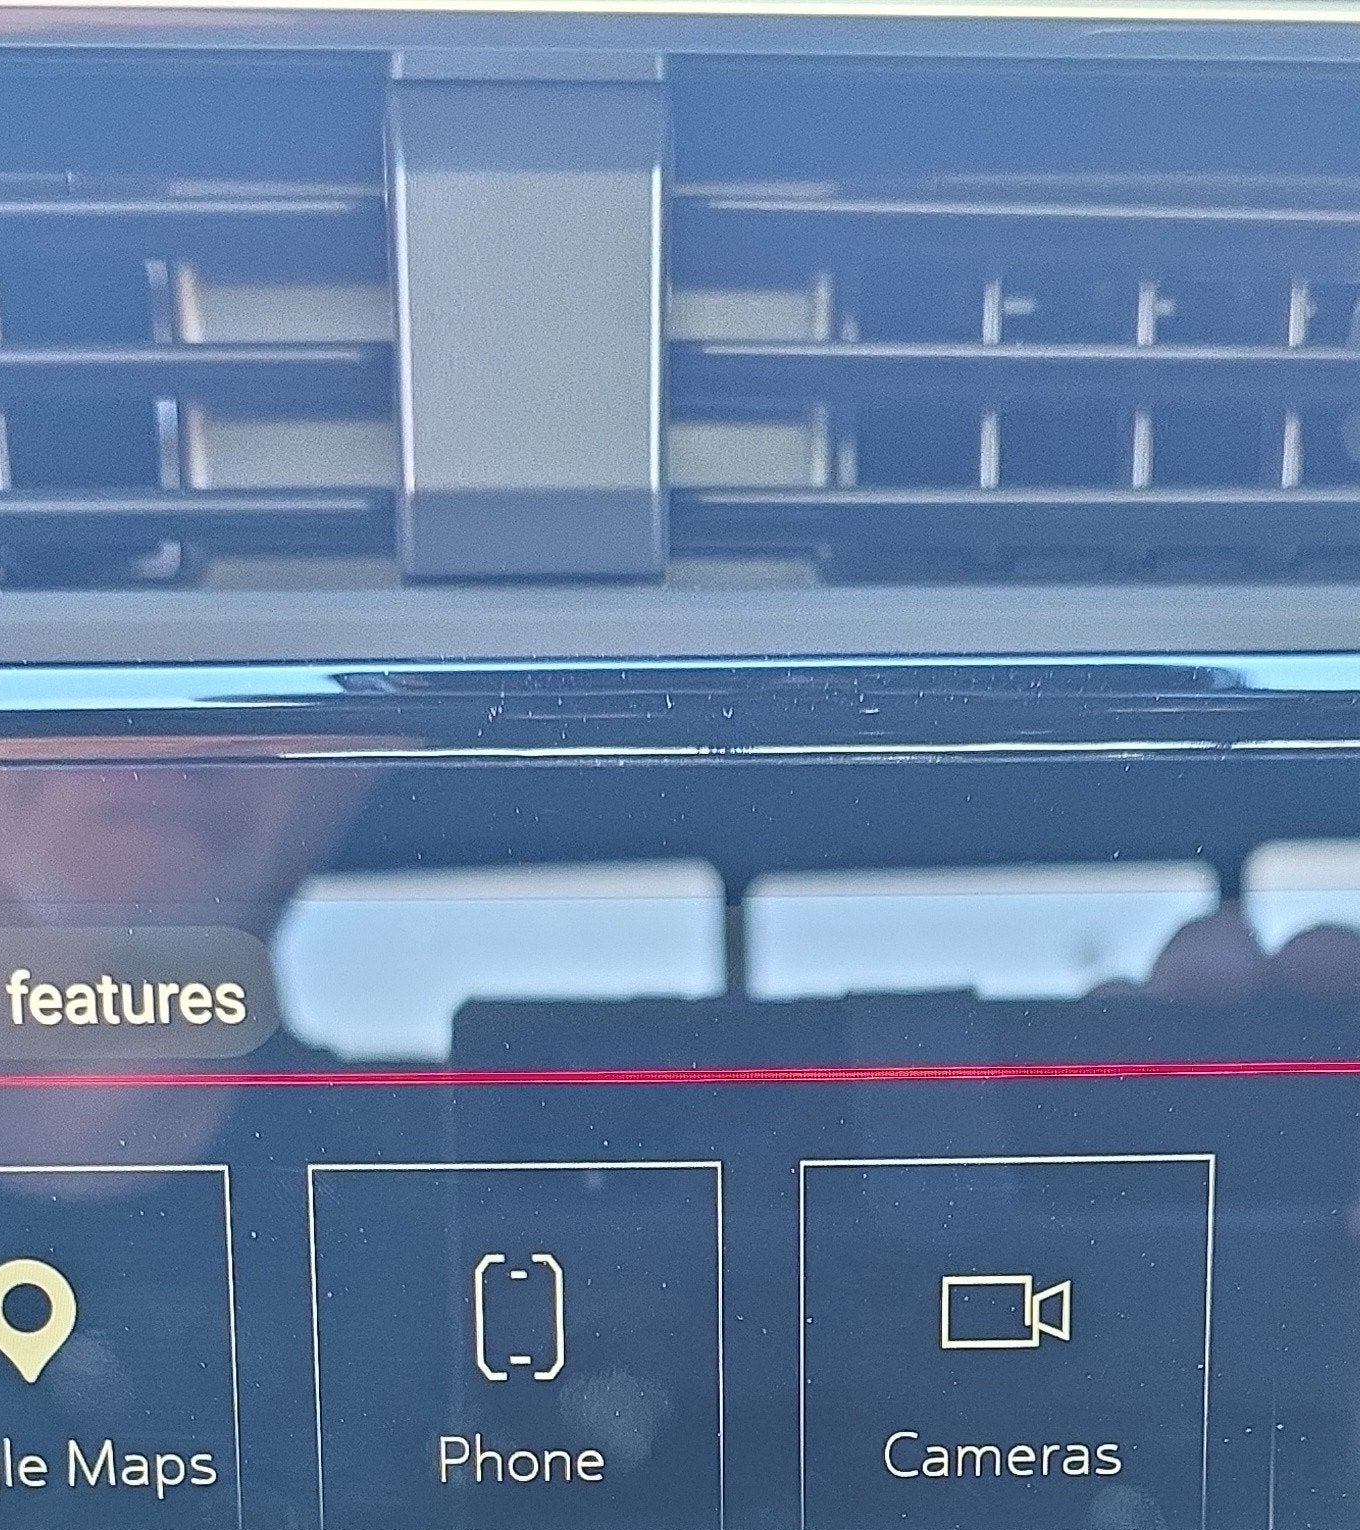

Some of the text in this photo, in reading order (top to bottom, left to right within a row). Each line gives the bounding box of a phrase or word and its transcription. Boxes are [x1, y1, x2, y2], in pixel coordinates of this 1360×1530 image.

[3, 970, 247, 1024] features
[66, 1438, 219, 1497] Maps
[436, 1434, 606, 1485] Phone
[881, 1430, 1125, 1479] Cameras
